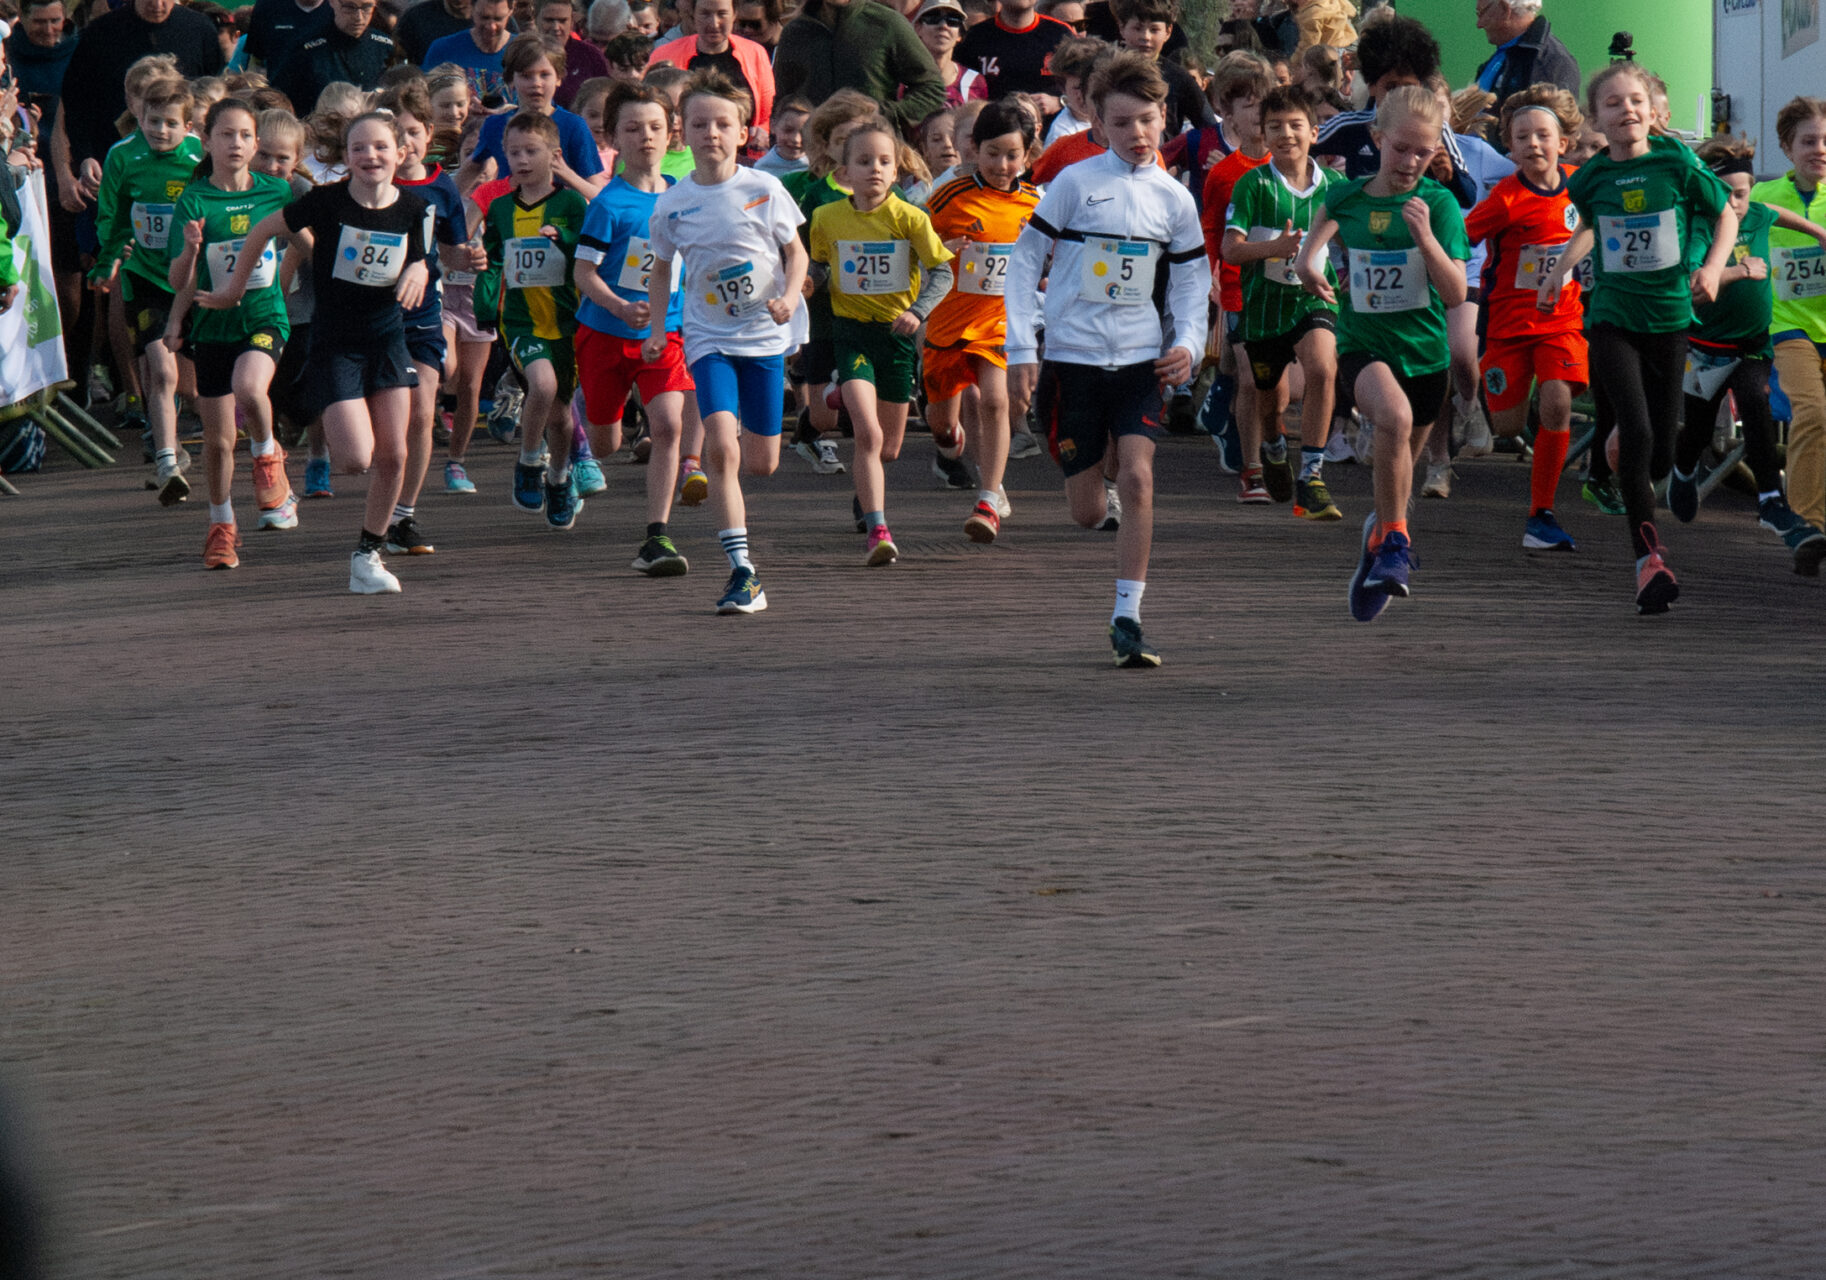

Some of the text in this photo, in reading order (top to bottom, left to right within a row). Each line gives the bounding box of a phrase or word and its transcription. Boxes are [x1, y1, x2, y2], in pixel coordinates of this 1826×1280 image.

[146, 216, 164, 233] 18
[1624, 230, 1652, 252] 29
[361, 246, 389, 267] 84
[515, 250, 545, 270] 109
[857, 255, 890, 275] 215
[985, 257, 1007, 276] 92
[1120, 257, 1134, 281] 5
[1364, 267, 1404, 290] 122
[1785, 258, 1826, 281] 254
[716, 276, 754, 303] 193
